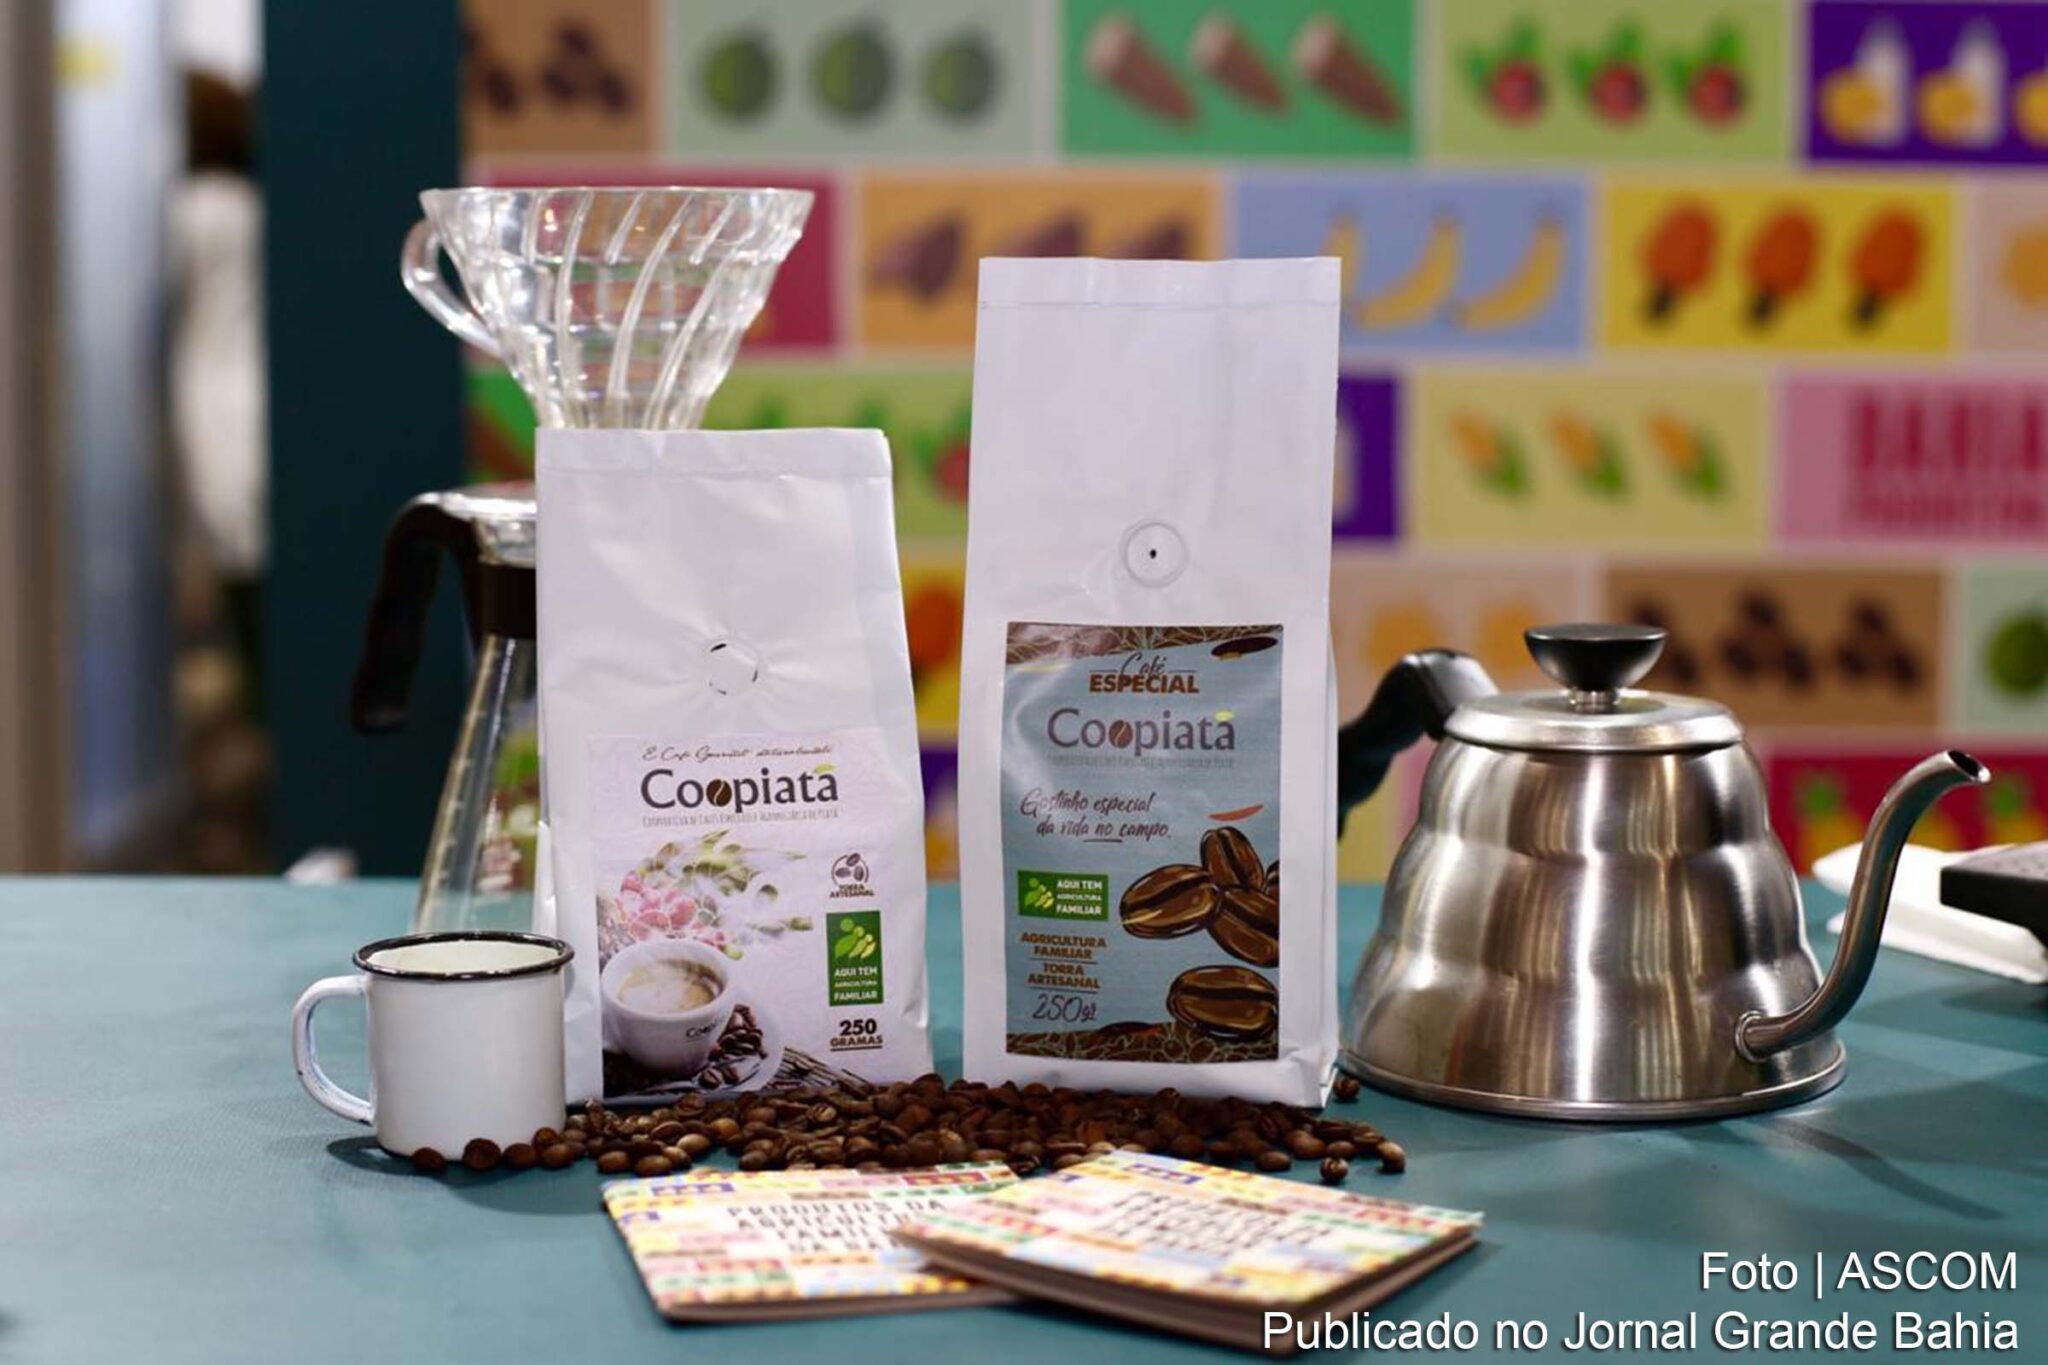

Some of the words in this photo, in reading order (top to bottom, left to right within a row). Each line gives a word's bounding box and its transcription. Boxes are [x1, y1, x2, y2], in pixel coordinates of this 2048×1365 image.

[1089, 674, 1200, 694] ESPECIAL
[1020, 788, 1089, 818] Gostinho
[1093, 792, 1157, 816] especial
[1036, 815, 1054, 837] da
[1061, 815, 1090, 837] vida
[1094, 822, 1114, 836] no
[1056, 879, 1080, 889] AQUI
[1081, 880, 1103, 890] TEM
[1056, 904, 1102, 915] FAMILIAR
[1021, 932, 1107, 948] AGRICULTURA
[1033, 945, 1093, 959] FAMILIAR
[834, 967, 856, 977] AQUI
[857, 966, 878, 976] TEM
[1043, 962, 1085, 975] TORRA
[1027, 973, 1101, 988] ARTESANAL
[833, 990, 878, 1001] FAMILIAR
[839, 1018, 877, 1036] 250
[830, 1034, 883, 1047] GRAMAS
